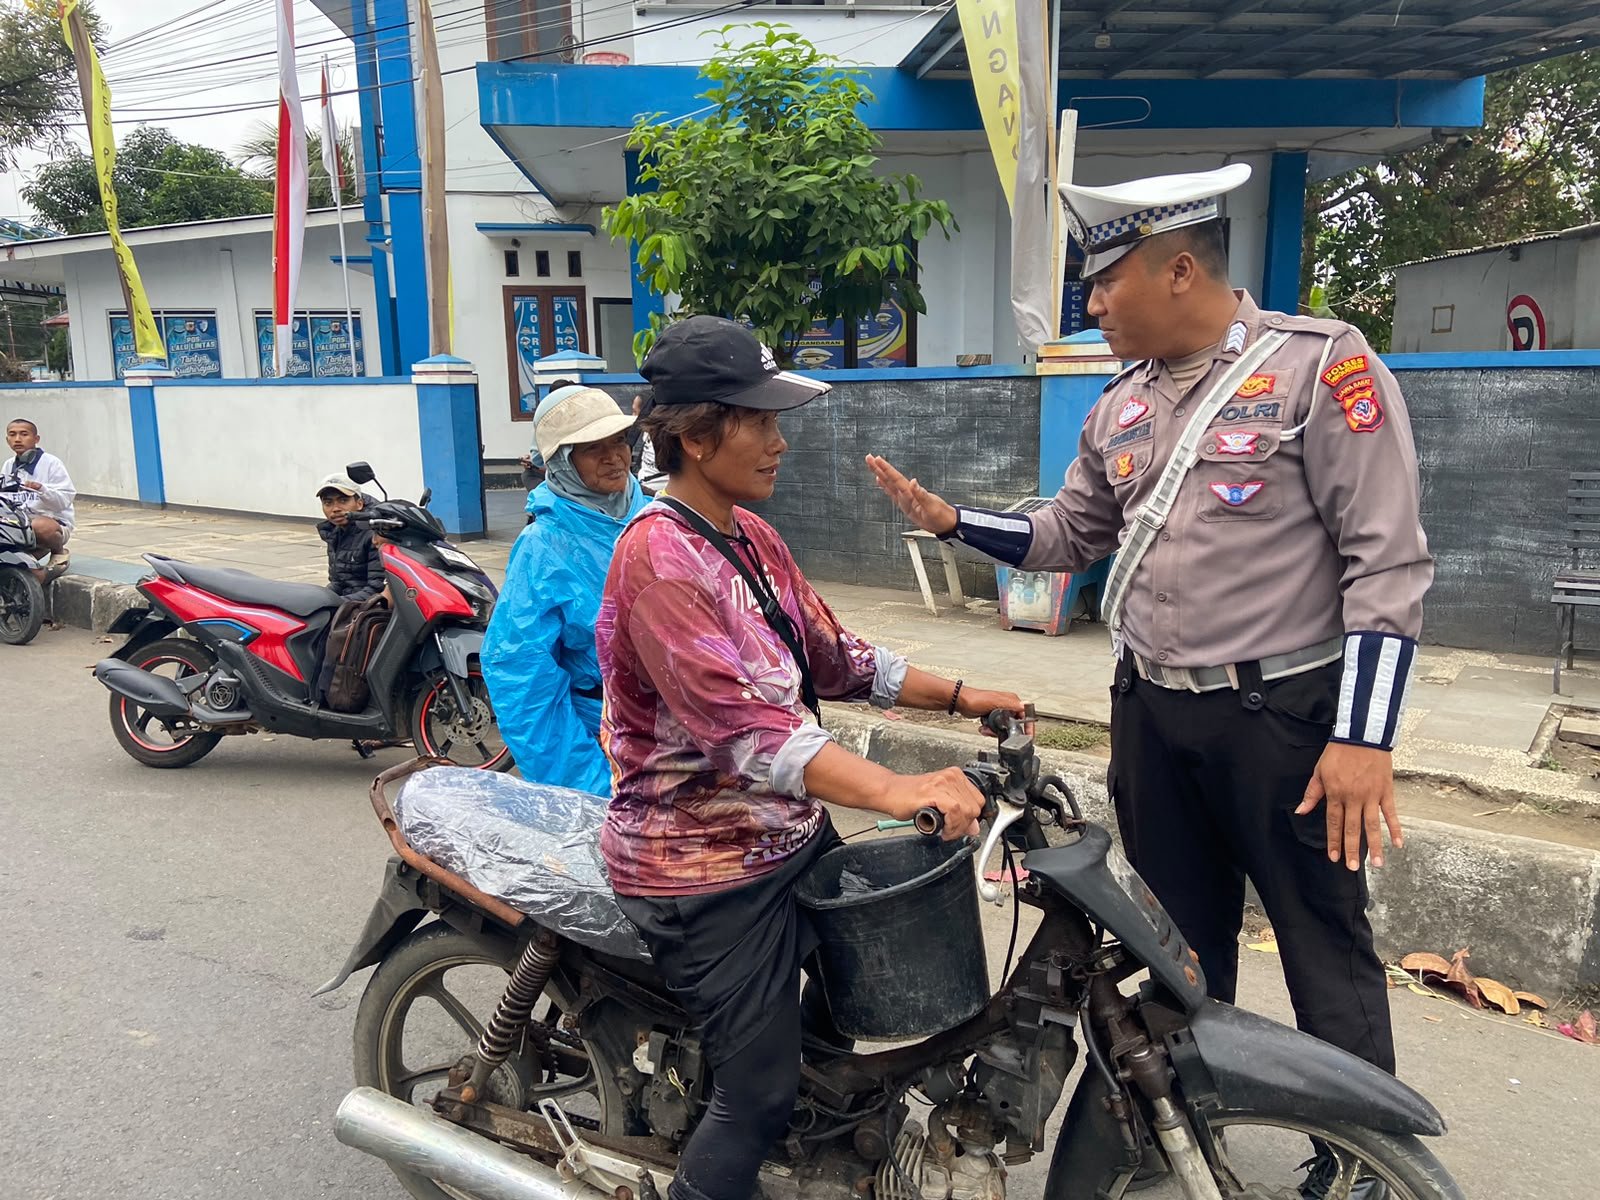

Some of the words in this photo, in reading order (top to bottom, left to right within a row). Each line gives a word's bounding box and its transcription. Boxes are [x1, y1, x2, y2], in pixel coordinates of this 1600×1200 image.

[529, 303, 540, 357] POLRE
[190, 341, 215, 349] LINTAS
[335, 341, 360, 349] LINTS
[1325, 357, 1364, 380] POLRES
[1217, 402, 1280, 421] OLRI
